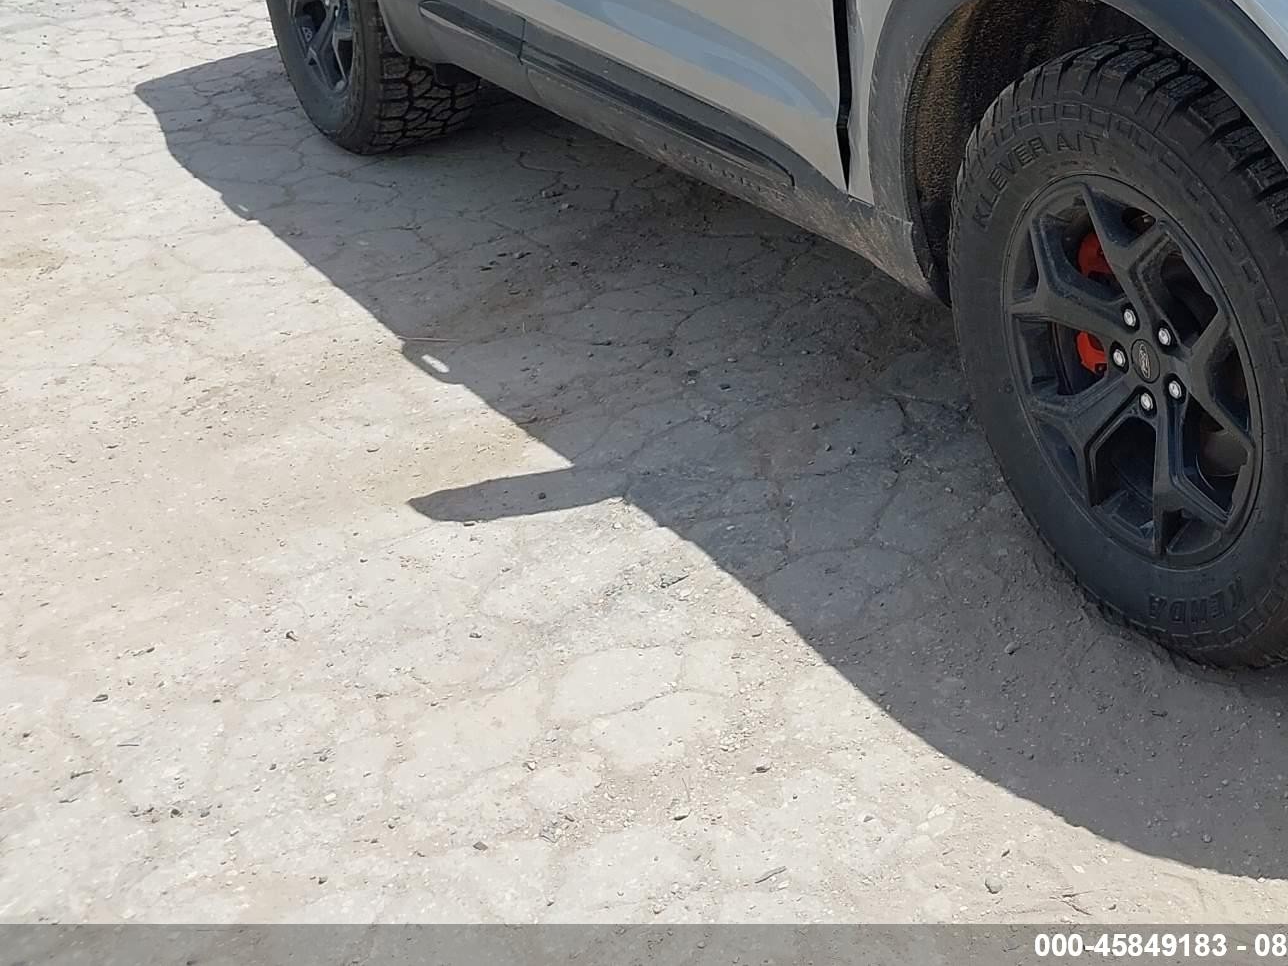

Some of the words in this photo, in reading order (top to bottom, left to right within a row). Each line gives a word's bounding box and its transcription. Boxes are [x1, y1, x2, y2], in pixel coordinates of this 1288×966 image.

[973, 136, 1051, 230] KLEVER
[1056, 130, 1104, 155] A/T
[1147, 577, 1247, 625] KENDA
